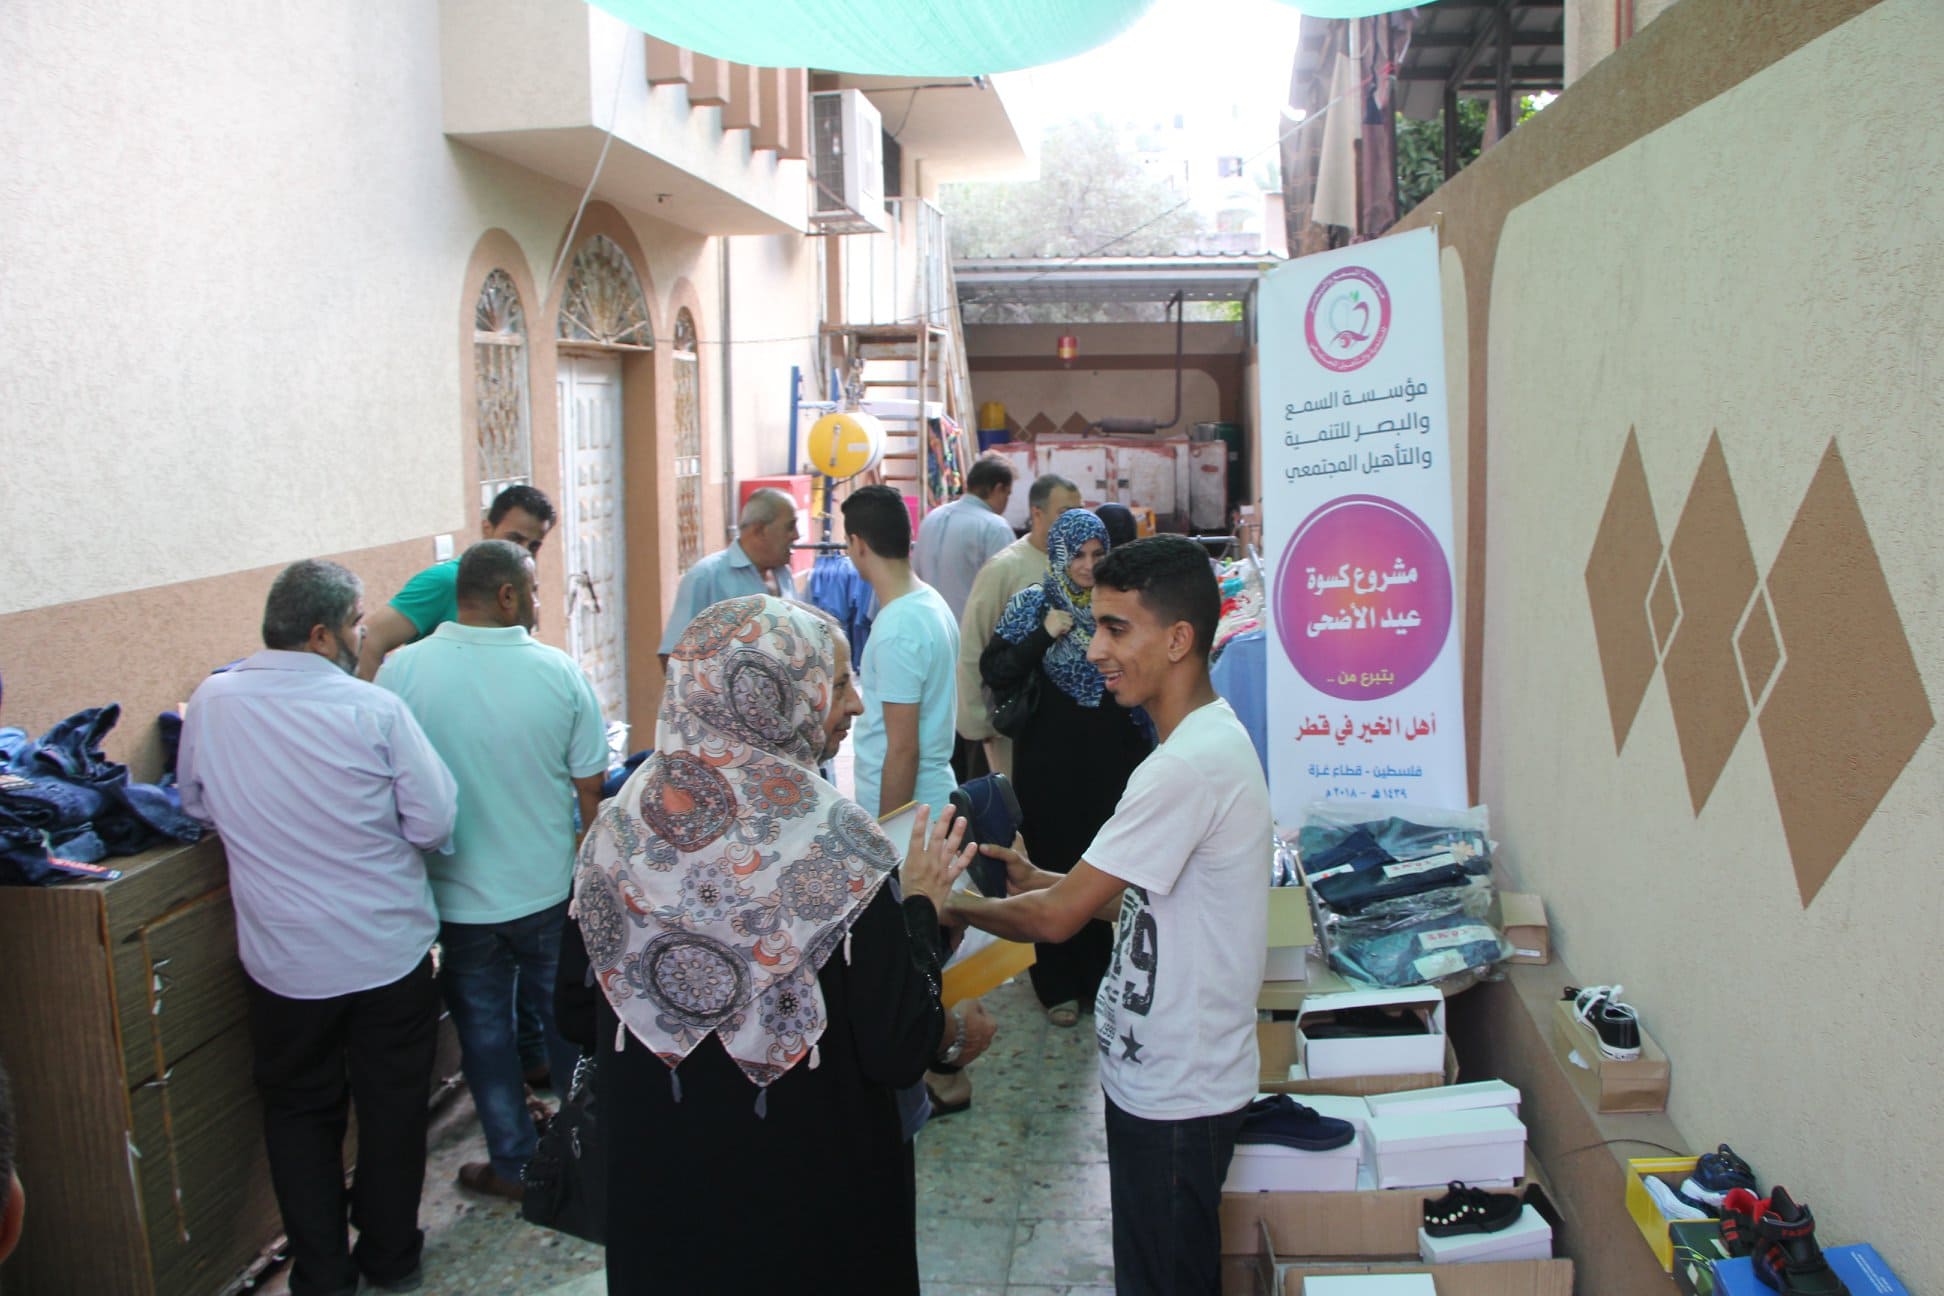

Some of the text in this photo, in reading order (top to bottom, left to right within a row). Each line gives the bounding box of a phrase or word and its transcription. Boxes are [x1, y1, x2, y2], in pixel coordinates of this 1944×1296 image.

[1285, 377, 1428, 421] مؤسسة السمع
[1284, 412, 1430, 450] والبصر للتنمية
[1285, 443, 1432, 484] والتأهيل المجتمعي
[1305, 557, 1418, 596] مشروع كسوة
[1306, 602, 1421, 638] عيد الأضحى
[1337, 671, 1357, 685] من
[1360, 668, 1395, 687] بتبرع
[1295, 712, 1437, 746] أهل الخير في قطر
[1308, 764, 1330, 778] غزة
[1332, 764, 1362, 778] قطاع
[1373, 764, 1423, 779] فلسطين
